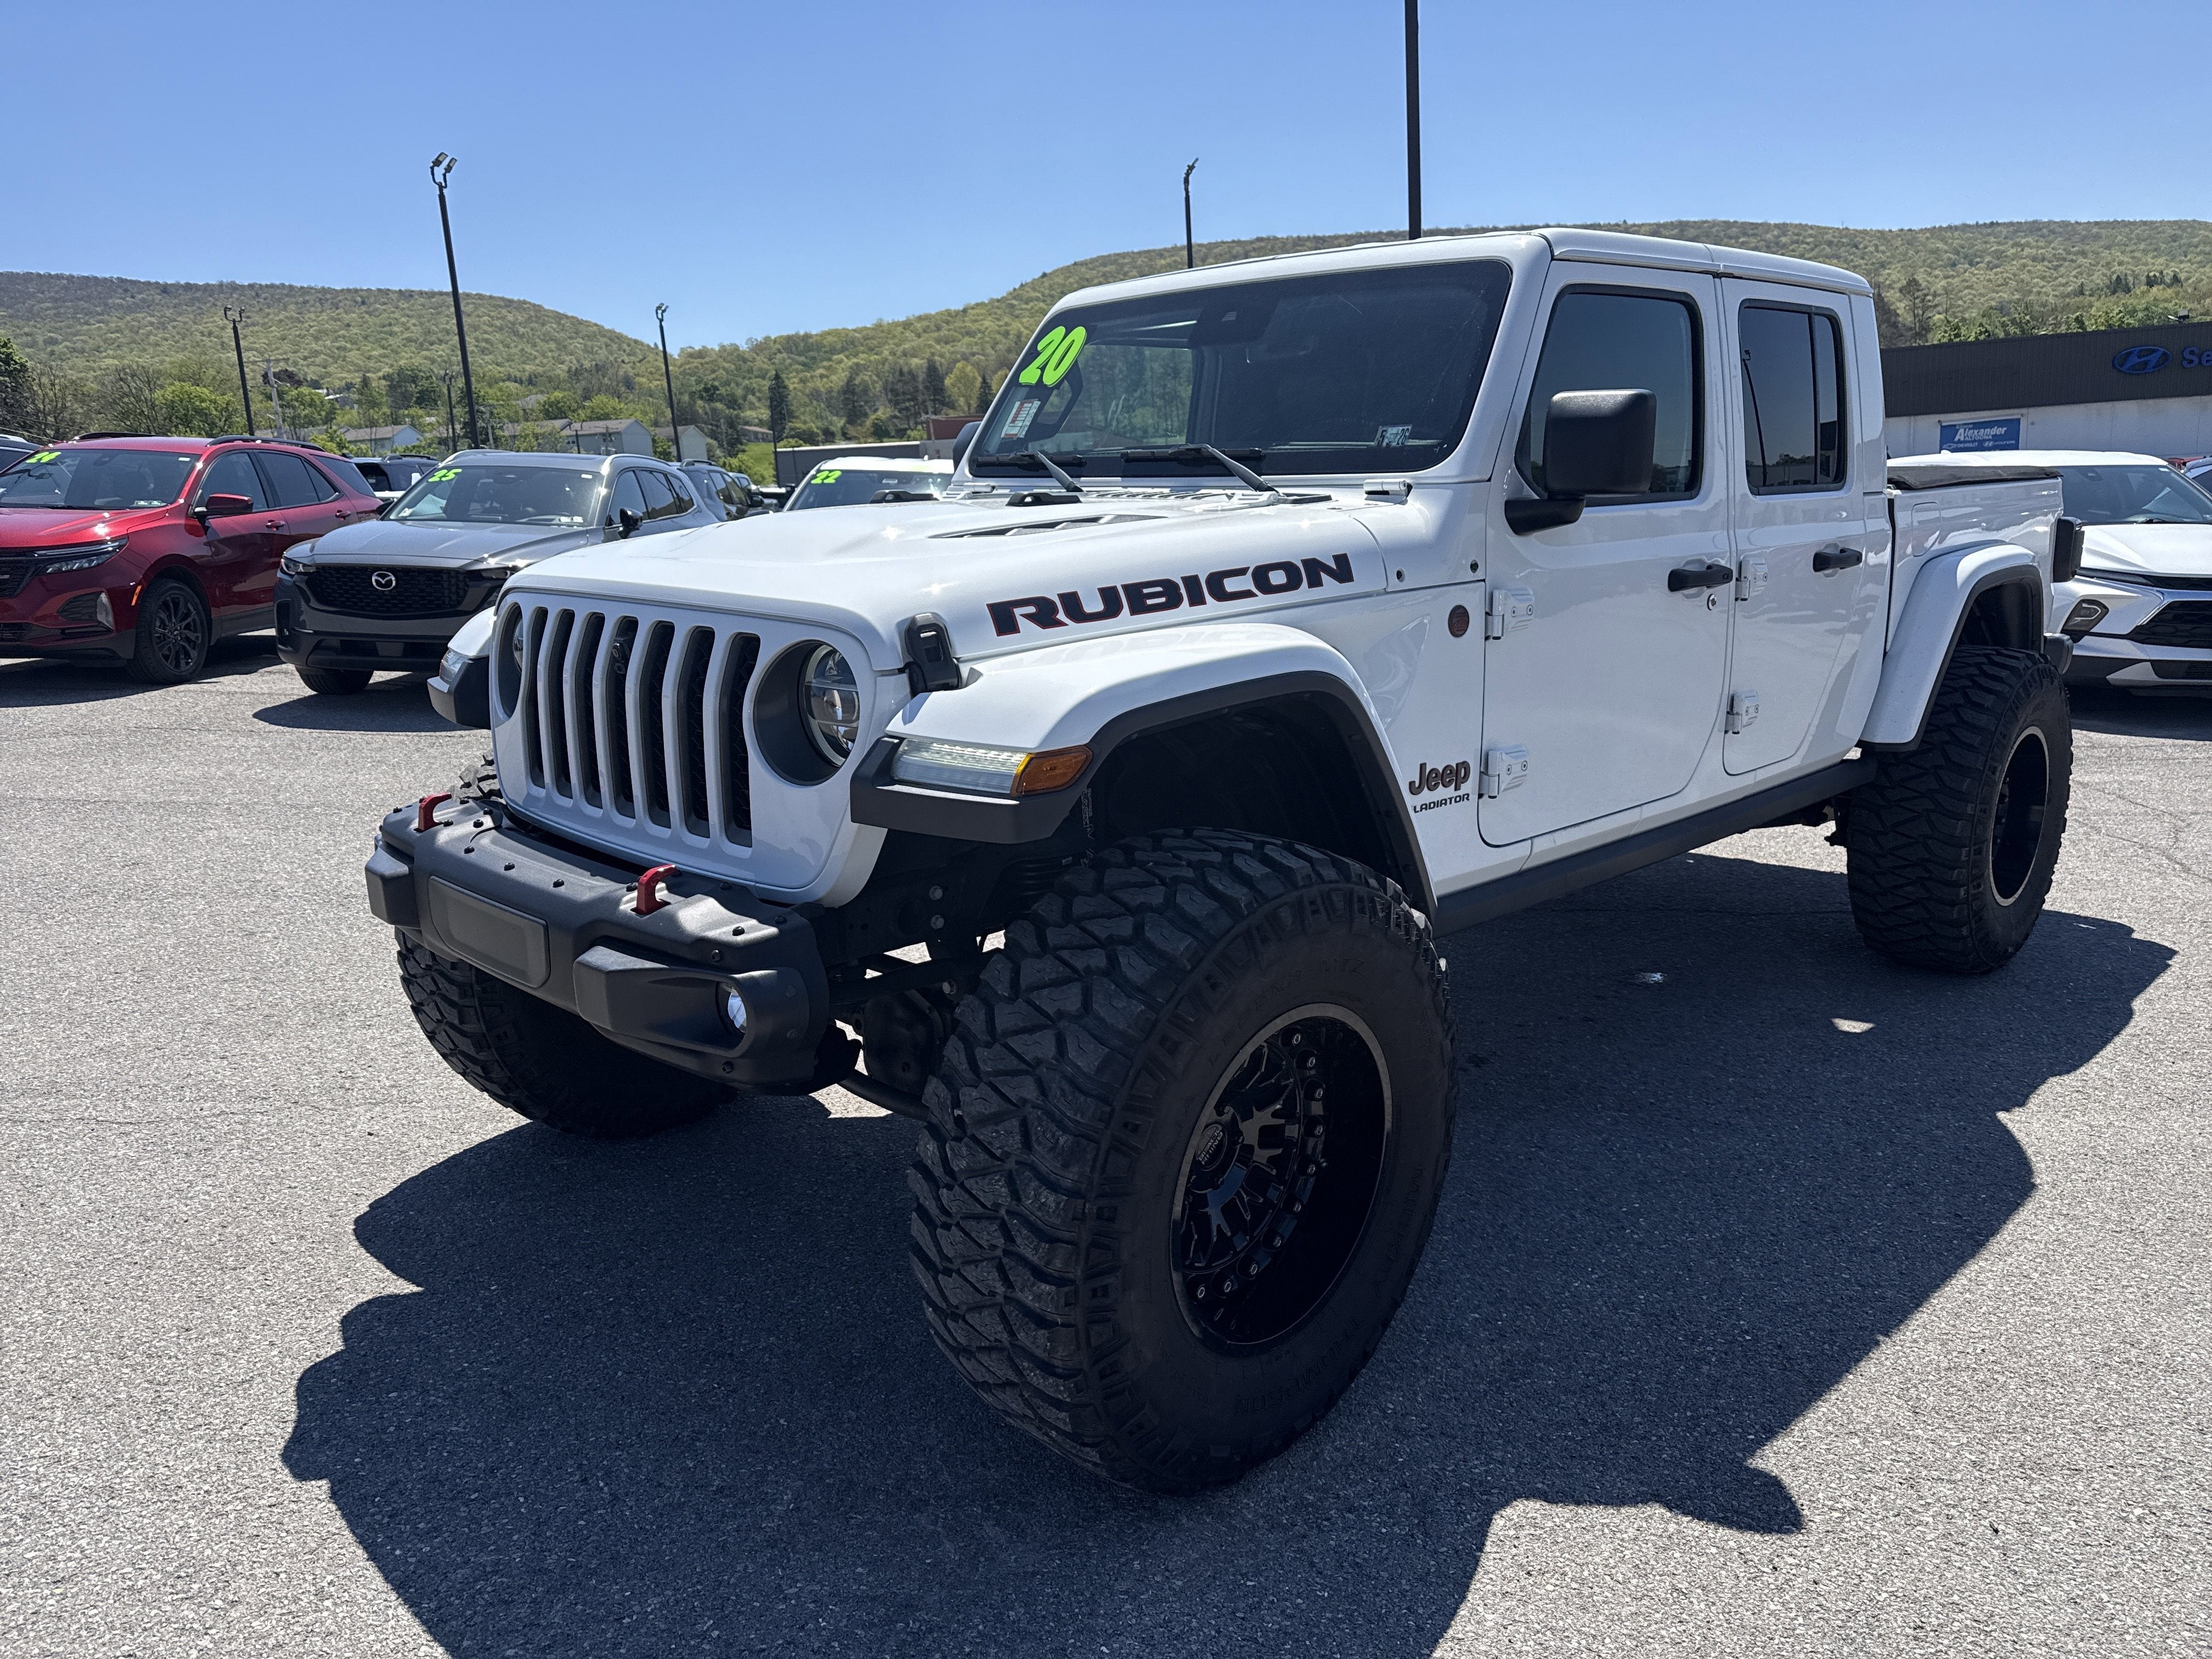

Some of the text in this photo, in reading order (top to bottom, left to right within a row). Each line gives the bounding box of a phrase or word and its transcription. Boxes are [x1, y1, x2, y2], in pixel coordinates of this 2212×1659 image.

[1019, 326, 1087, 387] 20
[1396, 428, 1409, 445] 26
[1954, 426, 2007, 442] Alexander
[428, 469, 462, 482] 25
[811, 470, 842, 484] 22
[985, 552, 1355, 637] RUBICON
[1408, 760, 1471, 795] Jeep
[1413, 793, 1470, 814] LADIATOR
